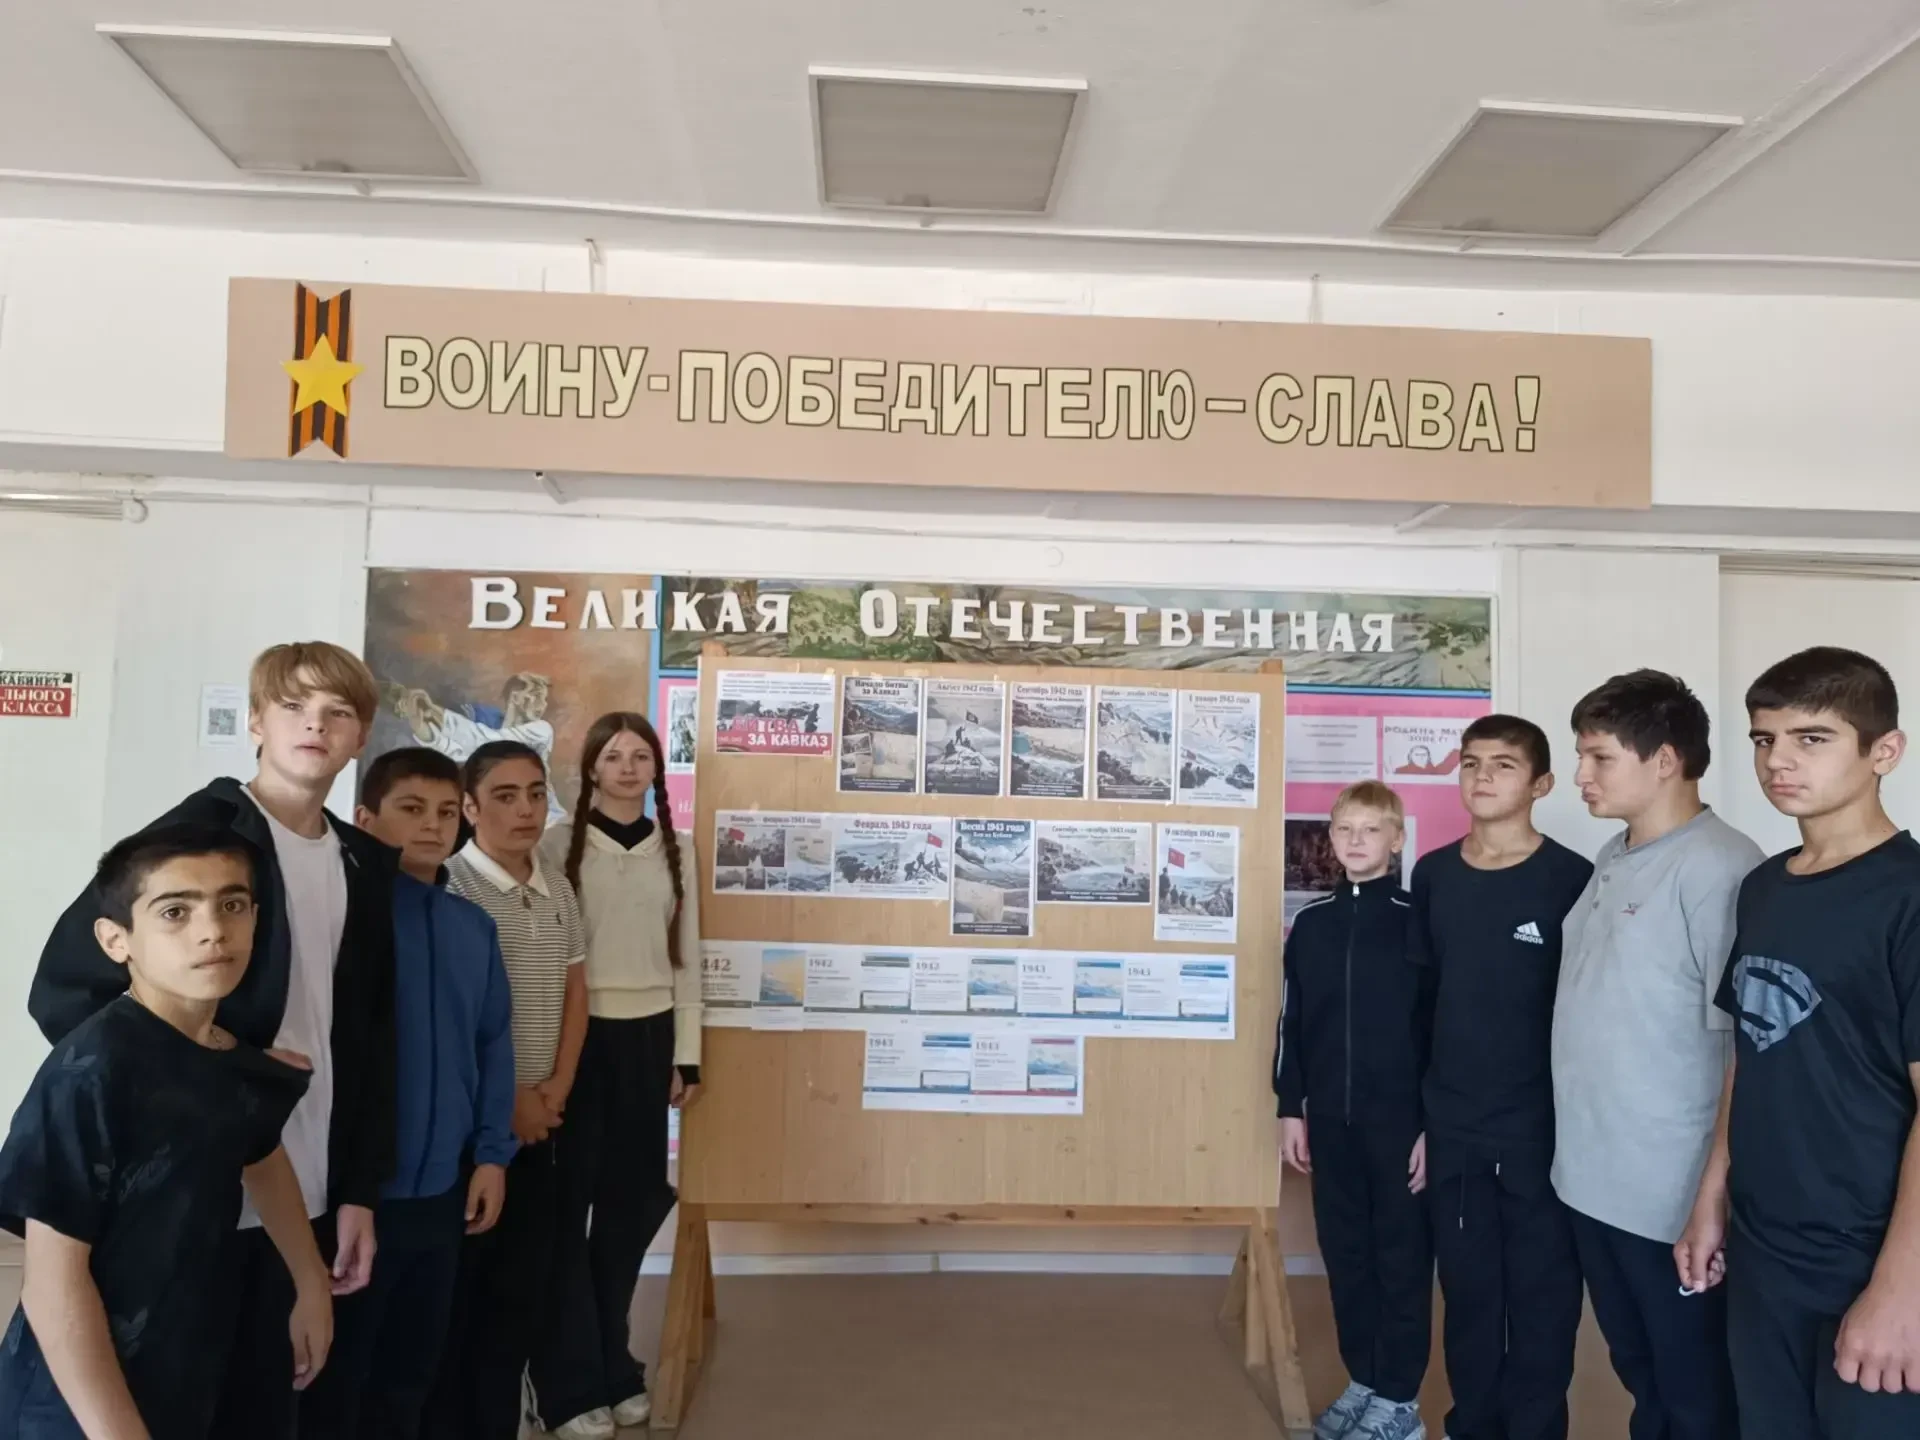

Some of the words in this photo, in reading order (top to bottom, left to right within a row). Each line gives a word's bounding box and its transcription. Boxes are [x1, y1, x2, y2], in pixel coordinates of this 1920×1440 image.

[0, 675, 60, 687] КАБИНЕТ
[2, 701, 64, 714] КЛАССА
[747, 734, 767, 746] ЗА
[771, 734, 829, 748] КАВКАЗ
[1513, 932, 1544, 945] adidas
